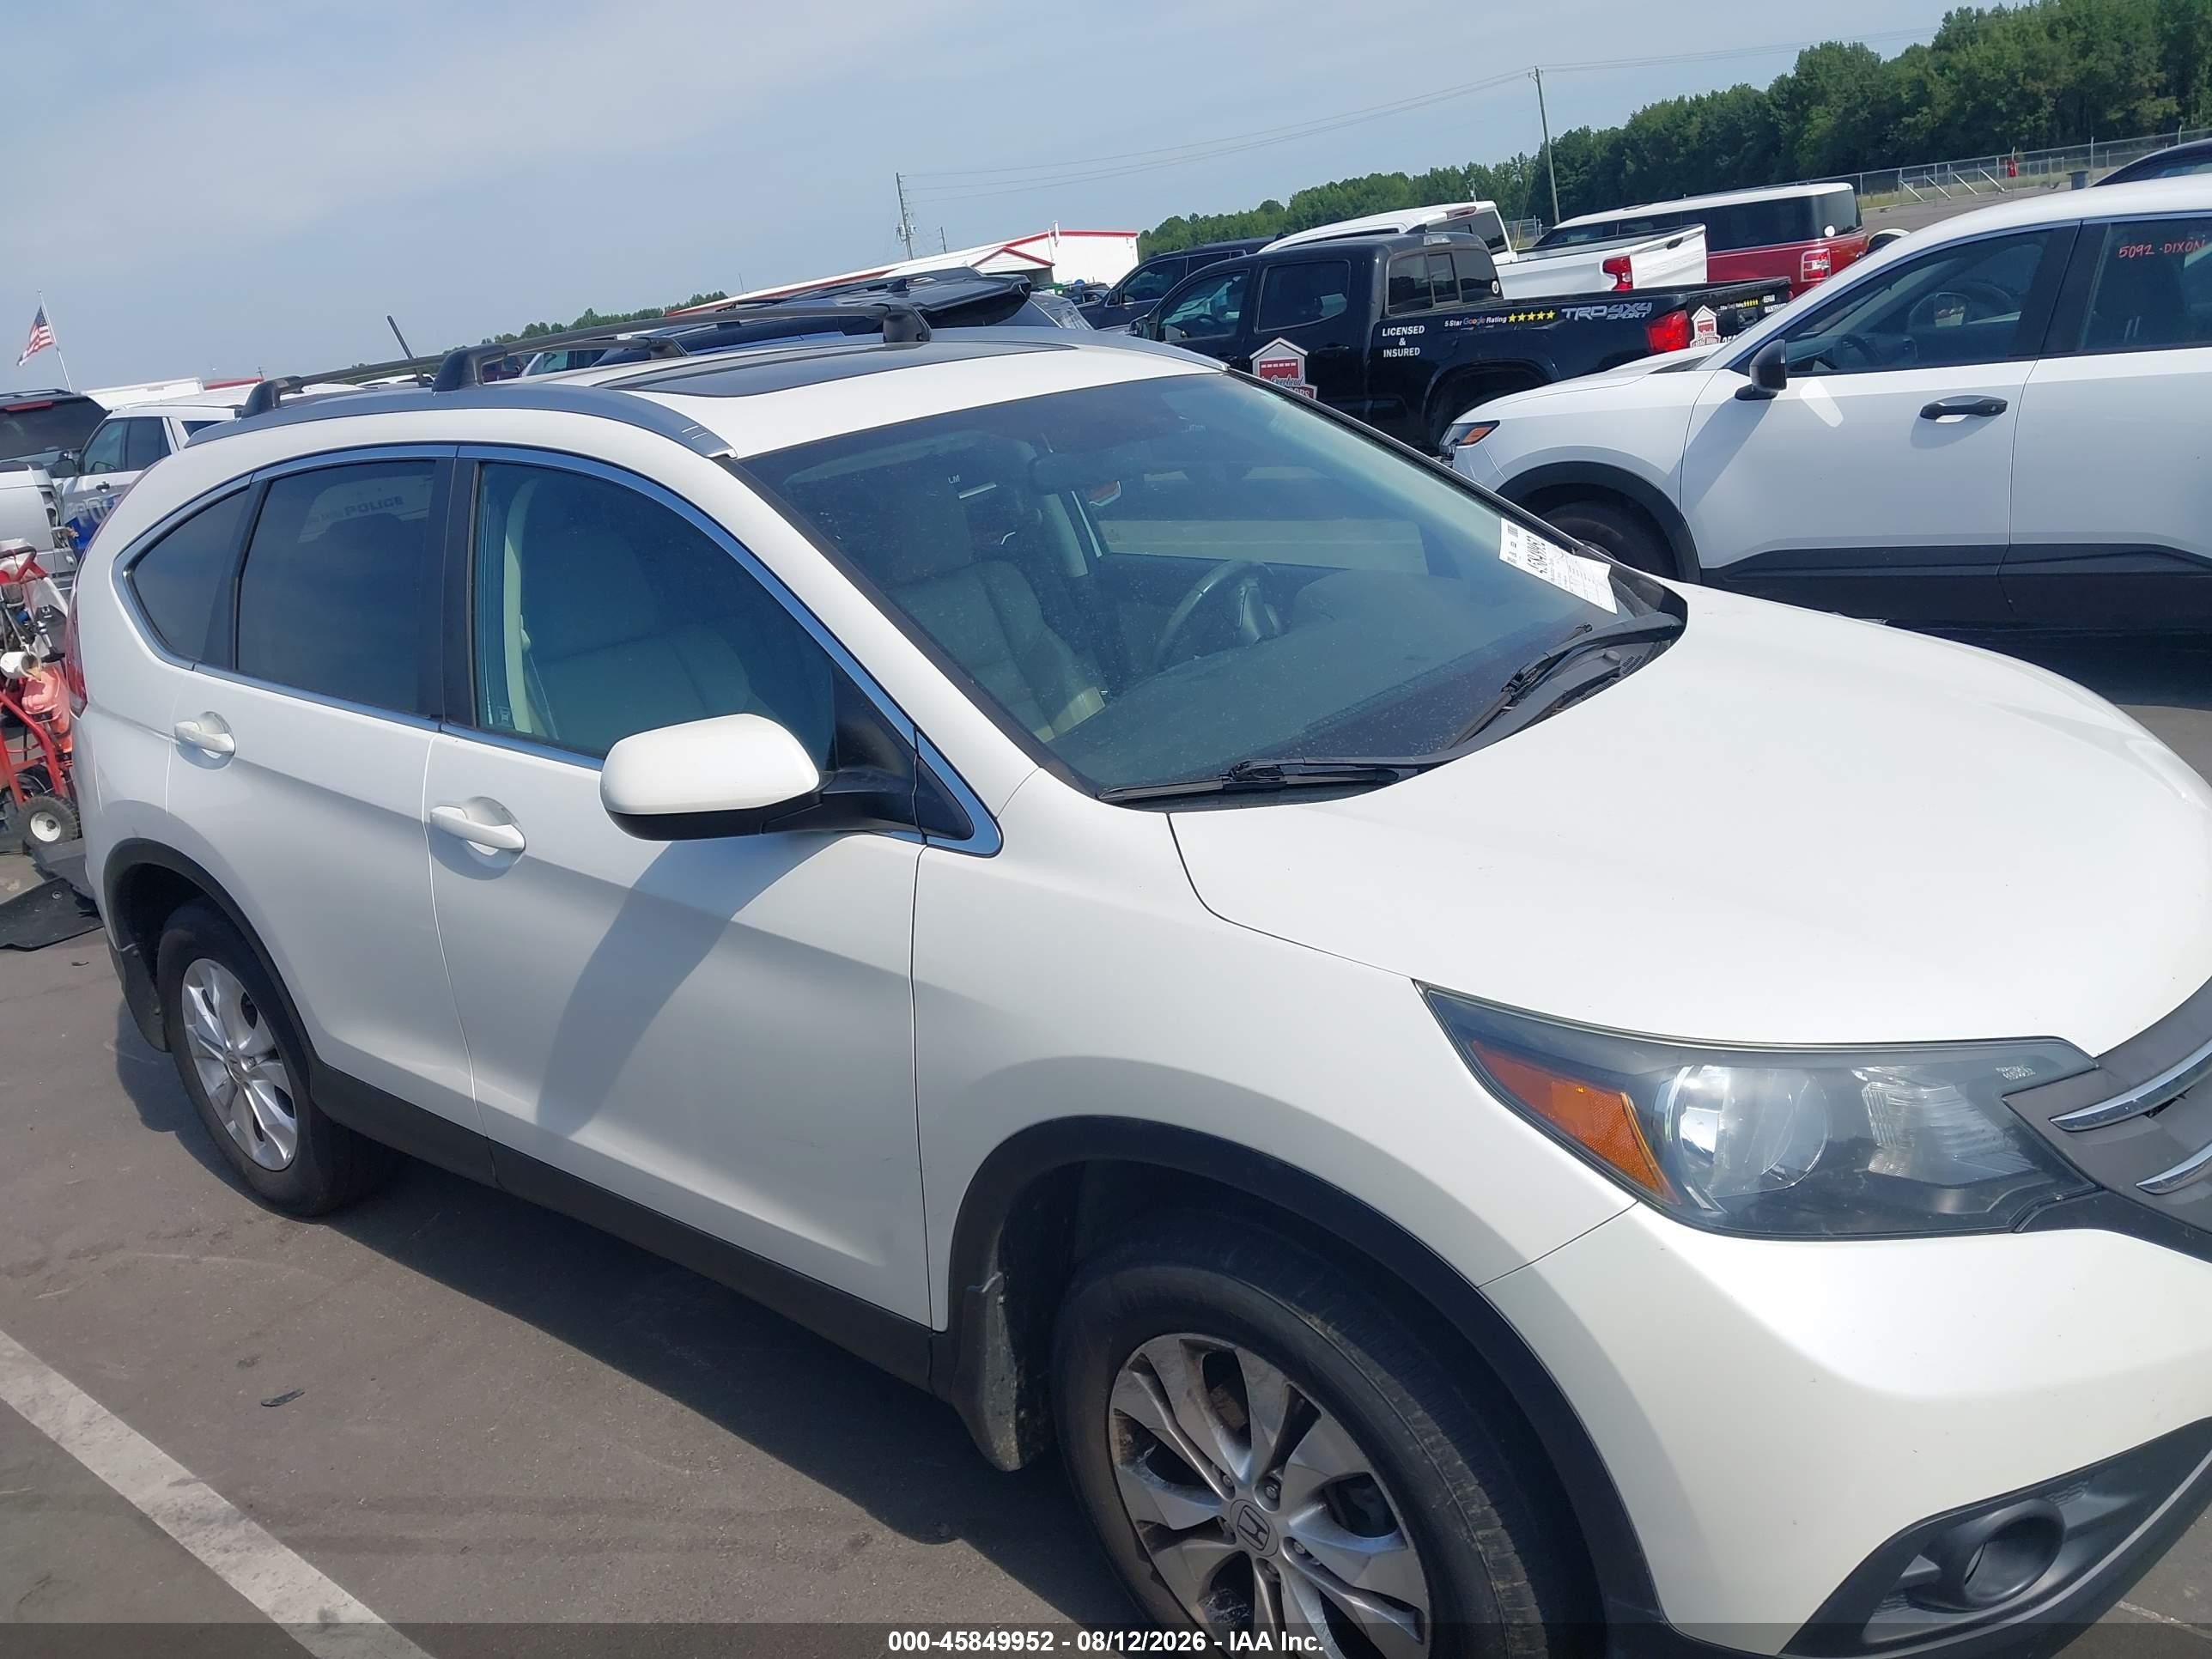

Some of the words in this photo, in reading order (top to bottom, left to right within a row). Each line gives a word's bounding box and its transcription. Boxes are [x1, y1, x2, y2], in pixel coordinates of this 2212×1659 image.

[2118, 244, 2155, 258] 5092
[1449, 318, 1462, 327] Star
[1486, 315, 1507, 325] Rating
[1382, 325, 1425, 337] LICENSED
[1399, 337, 1407, 346] &
[1383, 347, 1421, 358] INSURED
[344, 495, 404, 517] POLICE
